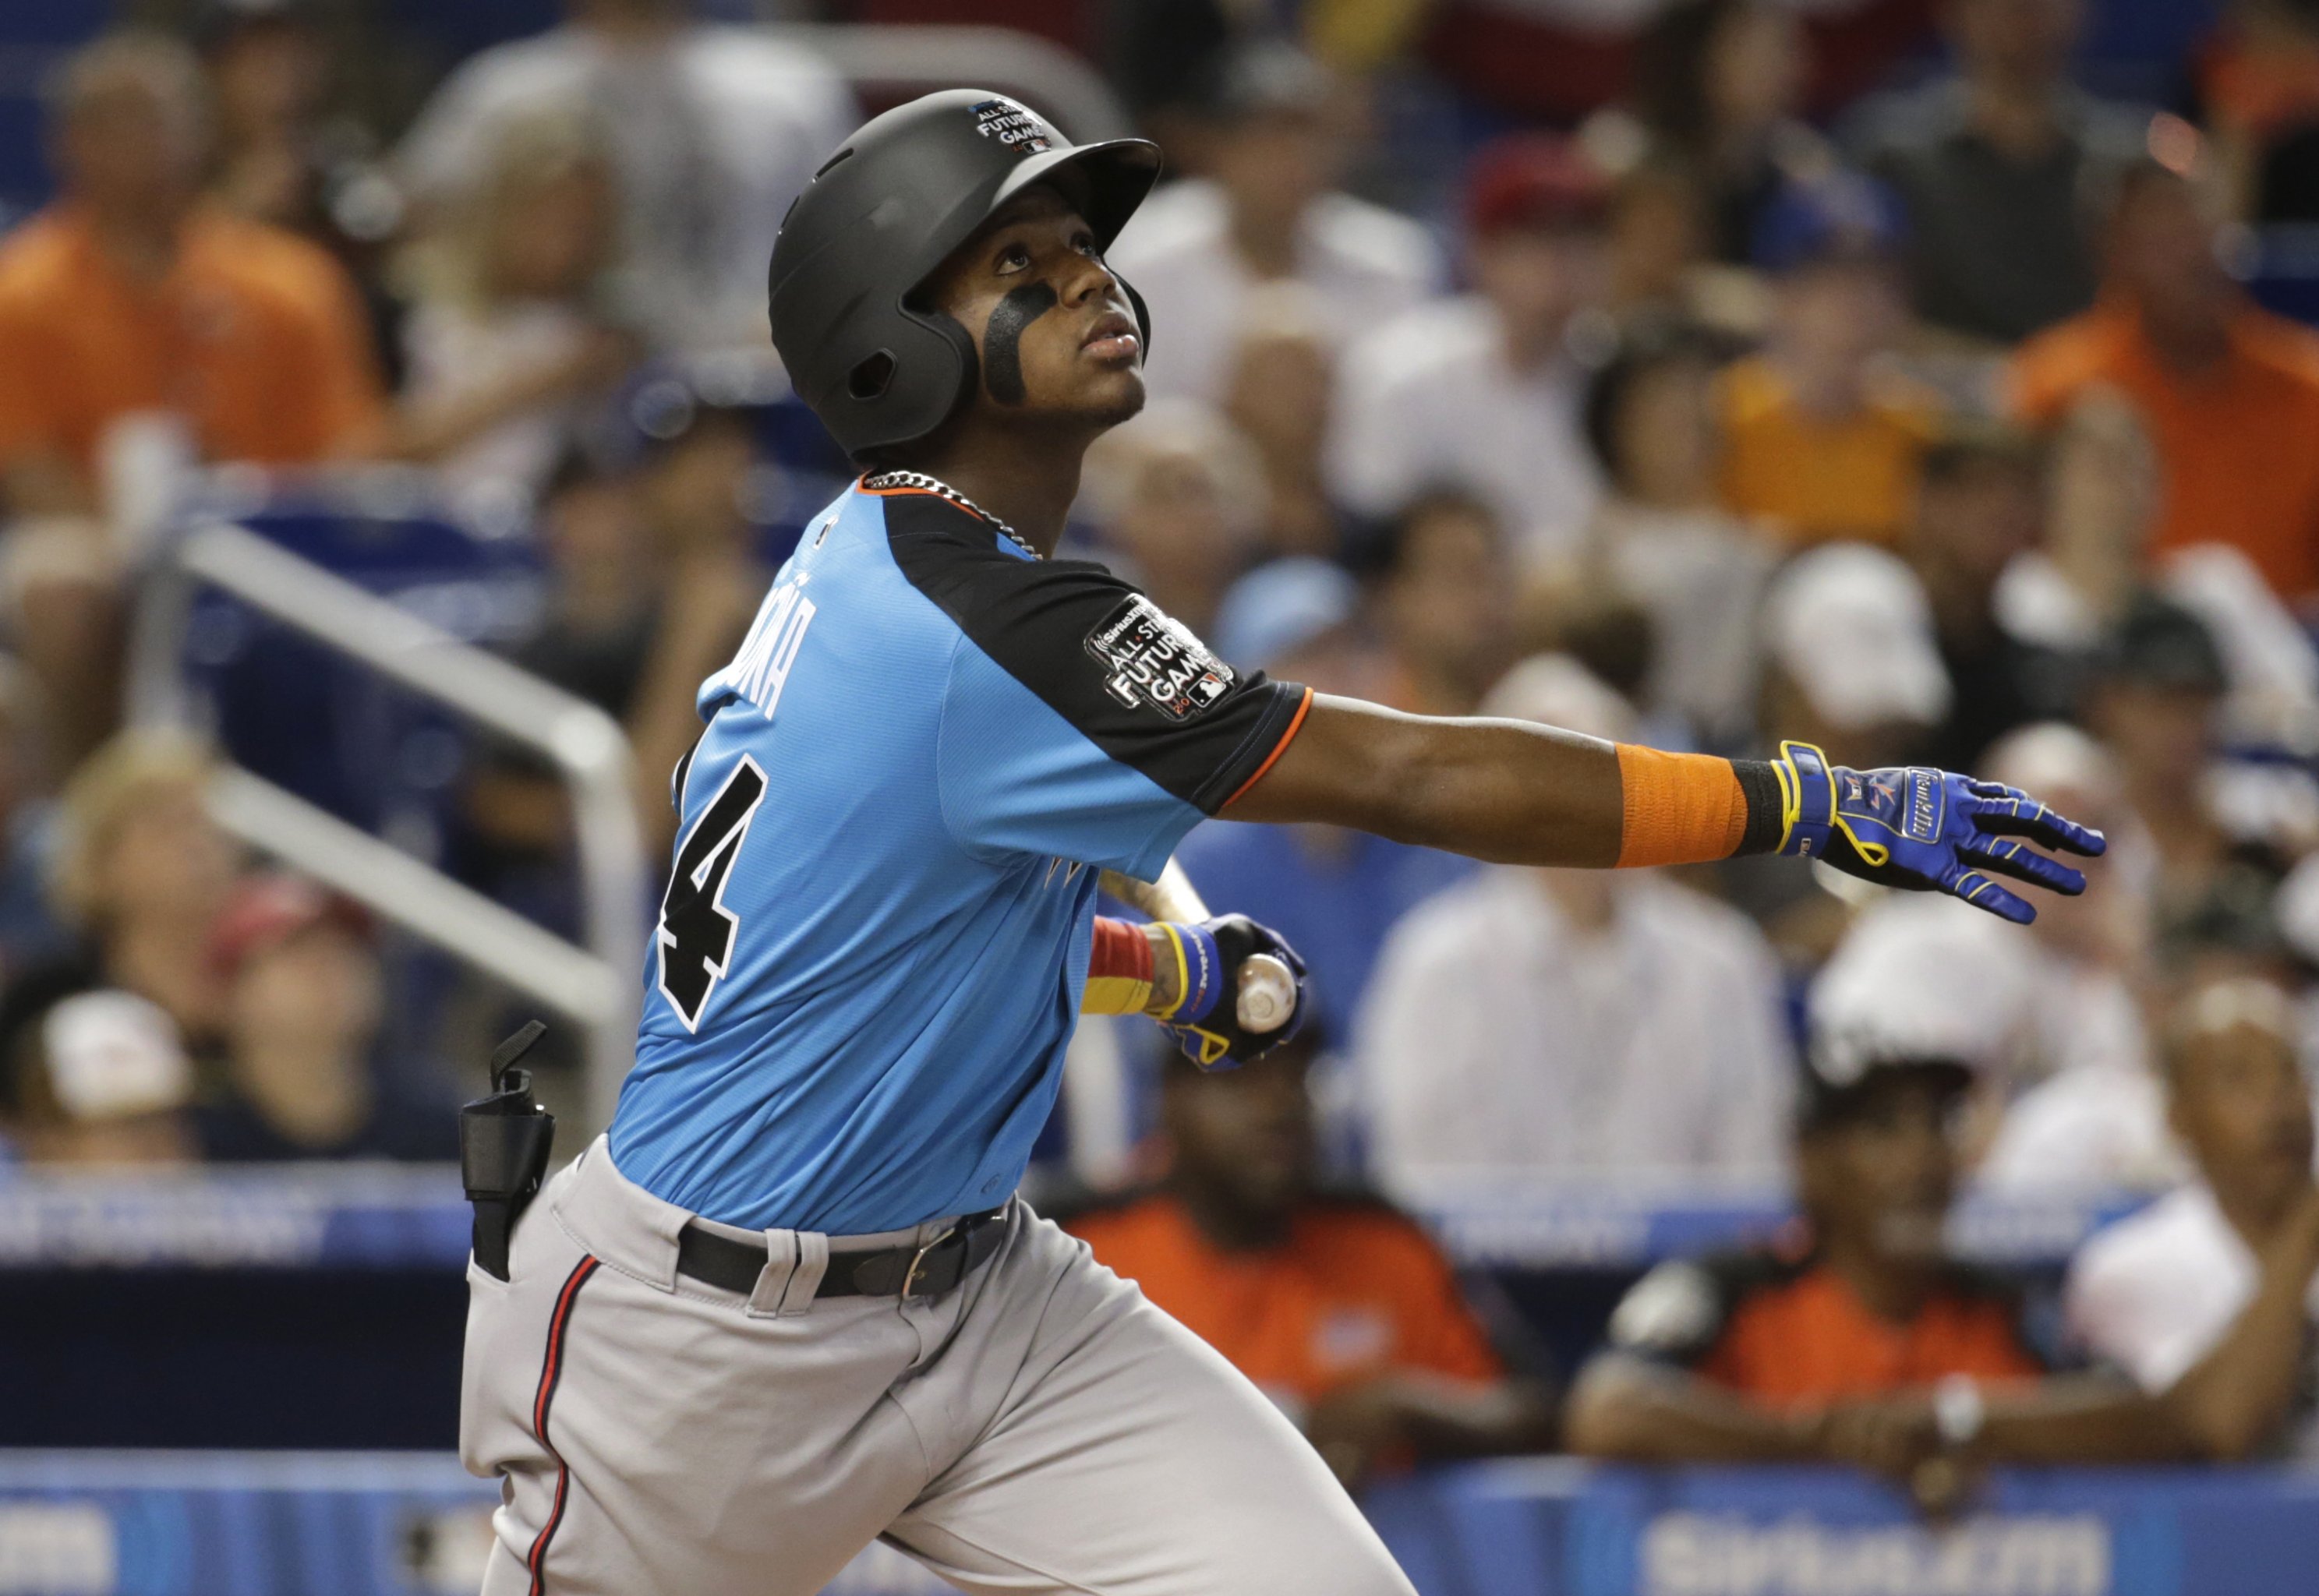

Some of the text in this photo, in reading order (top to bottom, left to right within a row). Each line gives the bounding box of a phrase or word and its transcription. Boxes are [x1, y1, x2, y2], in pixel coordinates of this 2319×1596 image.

[979, 109, 1000, 122] ALL
[1000, 125, 1045, 143] GAME
[1111, 640, 1144, 671] ALL
